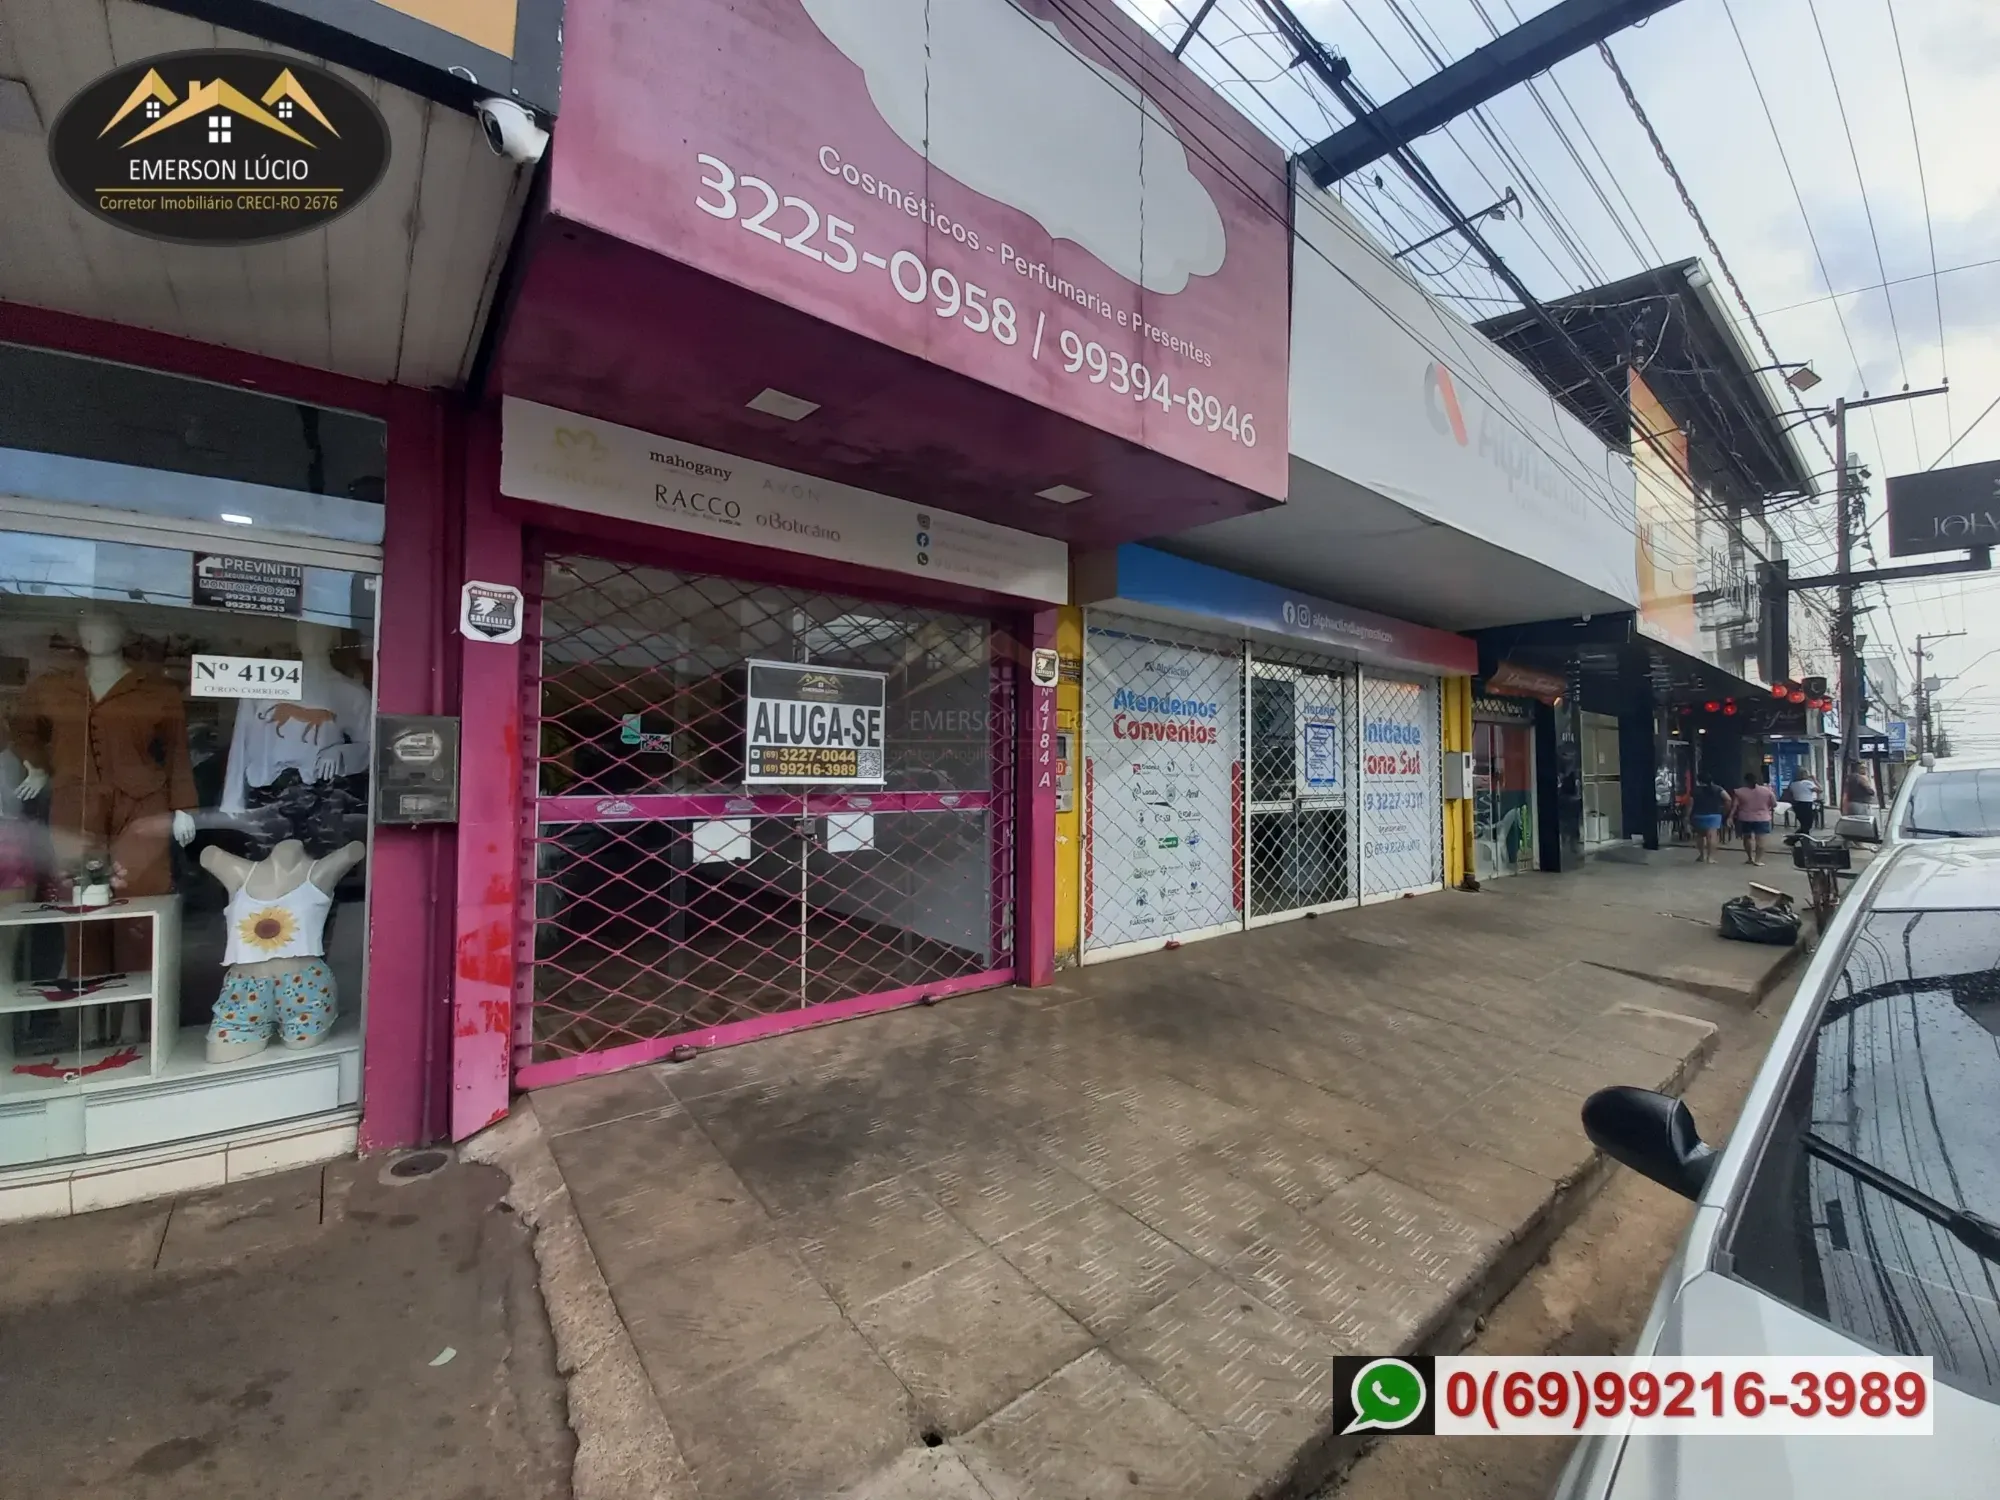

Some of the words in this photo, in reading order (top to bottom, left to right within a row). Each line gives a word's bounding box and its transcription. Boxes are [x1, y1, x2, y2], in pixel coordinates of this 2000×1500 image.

[818, 145, 981, 252] Cosméticos
[1000, 242, 1112, 320] Perfumaria
[1116, 311, 1128, 327] e
[1132, 312, 1213, 368] Presentes
[694, 152, 1018, 346] 3225-0958
[1059, 329, 1257, 448] 99394-8946
[649, 450, 733, 481] mahogany
[762, 479, 820, 503] AVON
[655, 484, 741, 518] RACCO
[224, 557, 301, 577] PREVINITTI
[200, 579, 275, 595] MONITORADO
[275, 587, 296, 598] 24H
[470, 613, 513, 625] SATELLITE
[237, 664, 300, 684] 4194
[204, 685, 239, 694] CERON
[241, 686, 290, 696] CORREIOS
[1113, 687, 1217, 718] Atendemos
[752, 701, 881, 748] ALUGA-SE
[1113, 713, 1217, 744] Convênios
[763, 750, 779, 760] (69)
[779, 748, 856, 762] 3227-0044
[1400, 750, 1421, 775] Sul
[763, 764, 779, 774] (69)
[779, 763, 856, 776] 99216-3989
